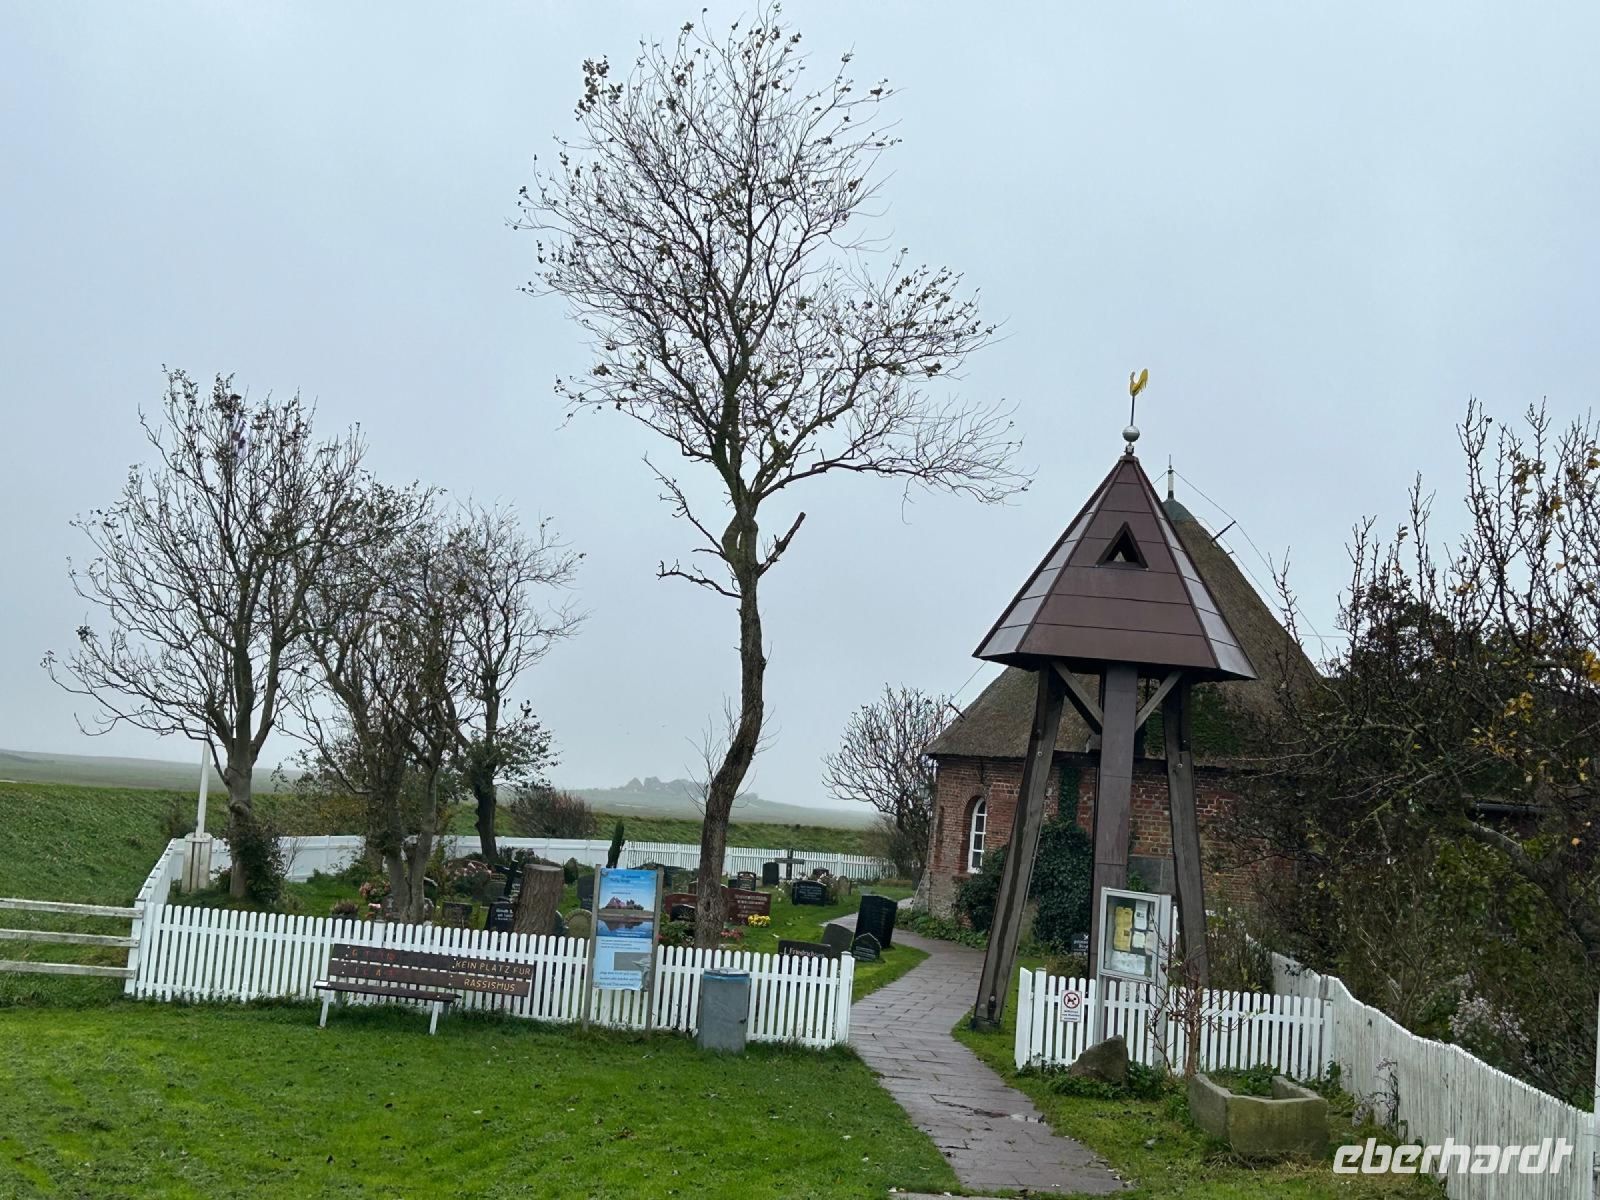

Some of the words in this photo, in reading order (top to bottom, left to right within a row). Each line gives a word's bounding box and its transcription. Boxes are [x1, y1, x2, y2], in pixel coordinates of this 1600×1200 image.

[455, 960, 477, 970] KEIN
[479, 962, 511, 974] PLATZ
[463, 978, 516, 992] RASSISMUS
